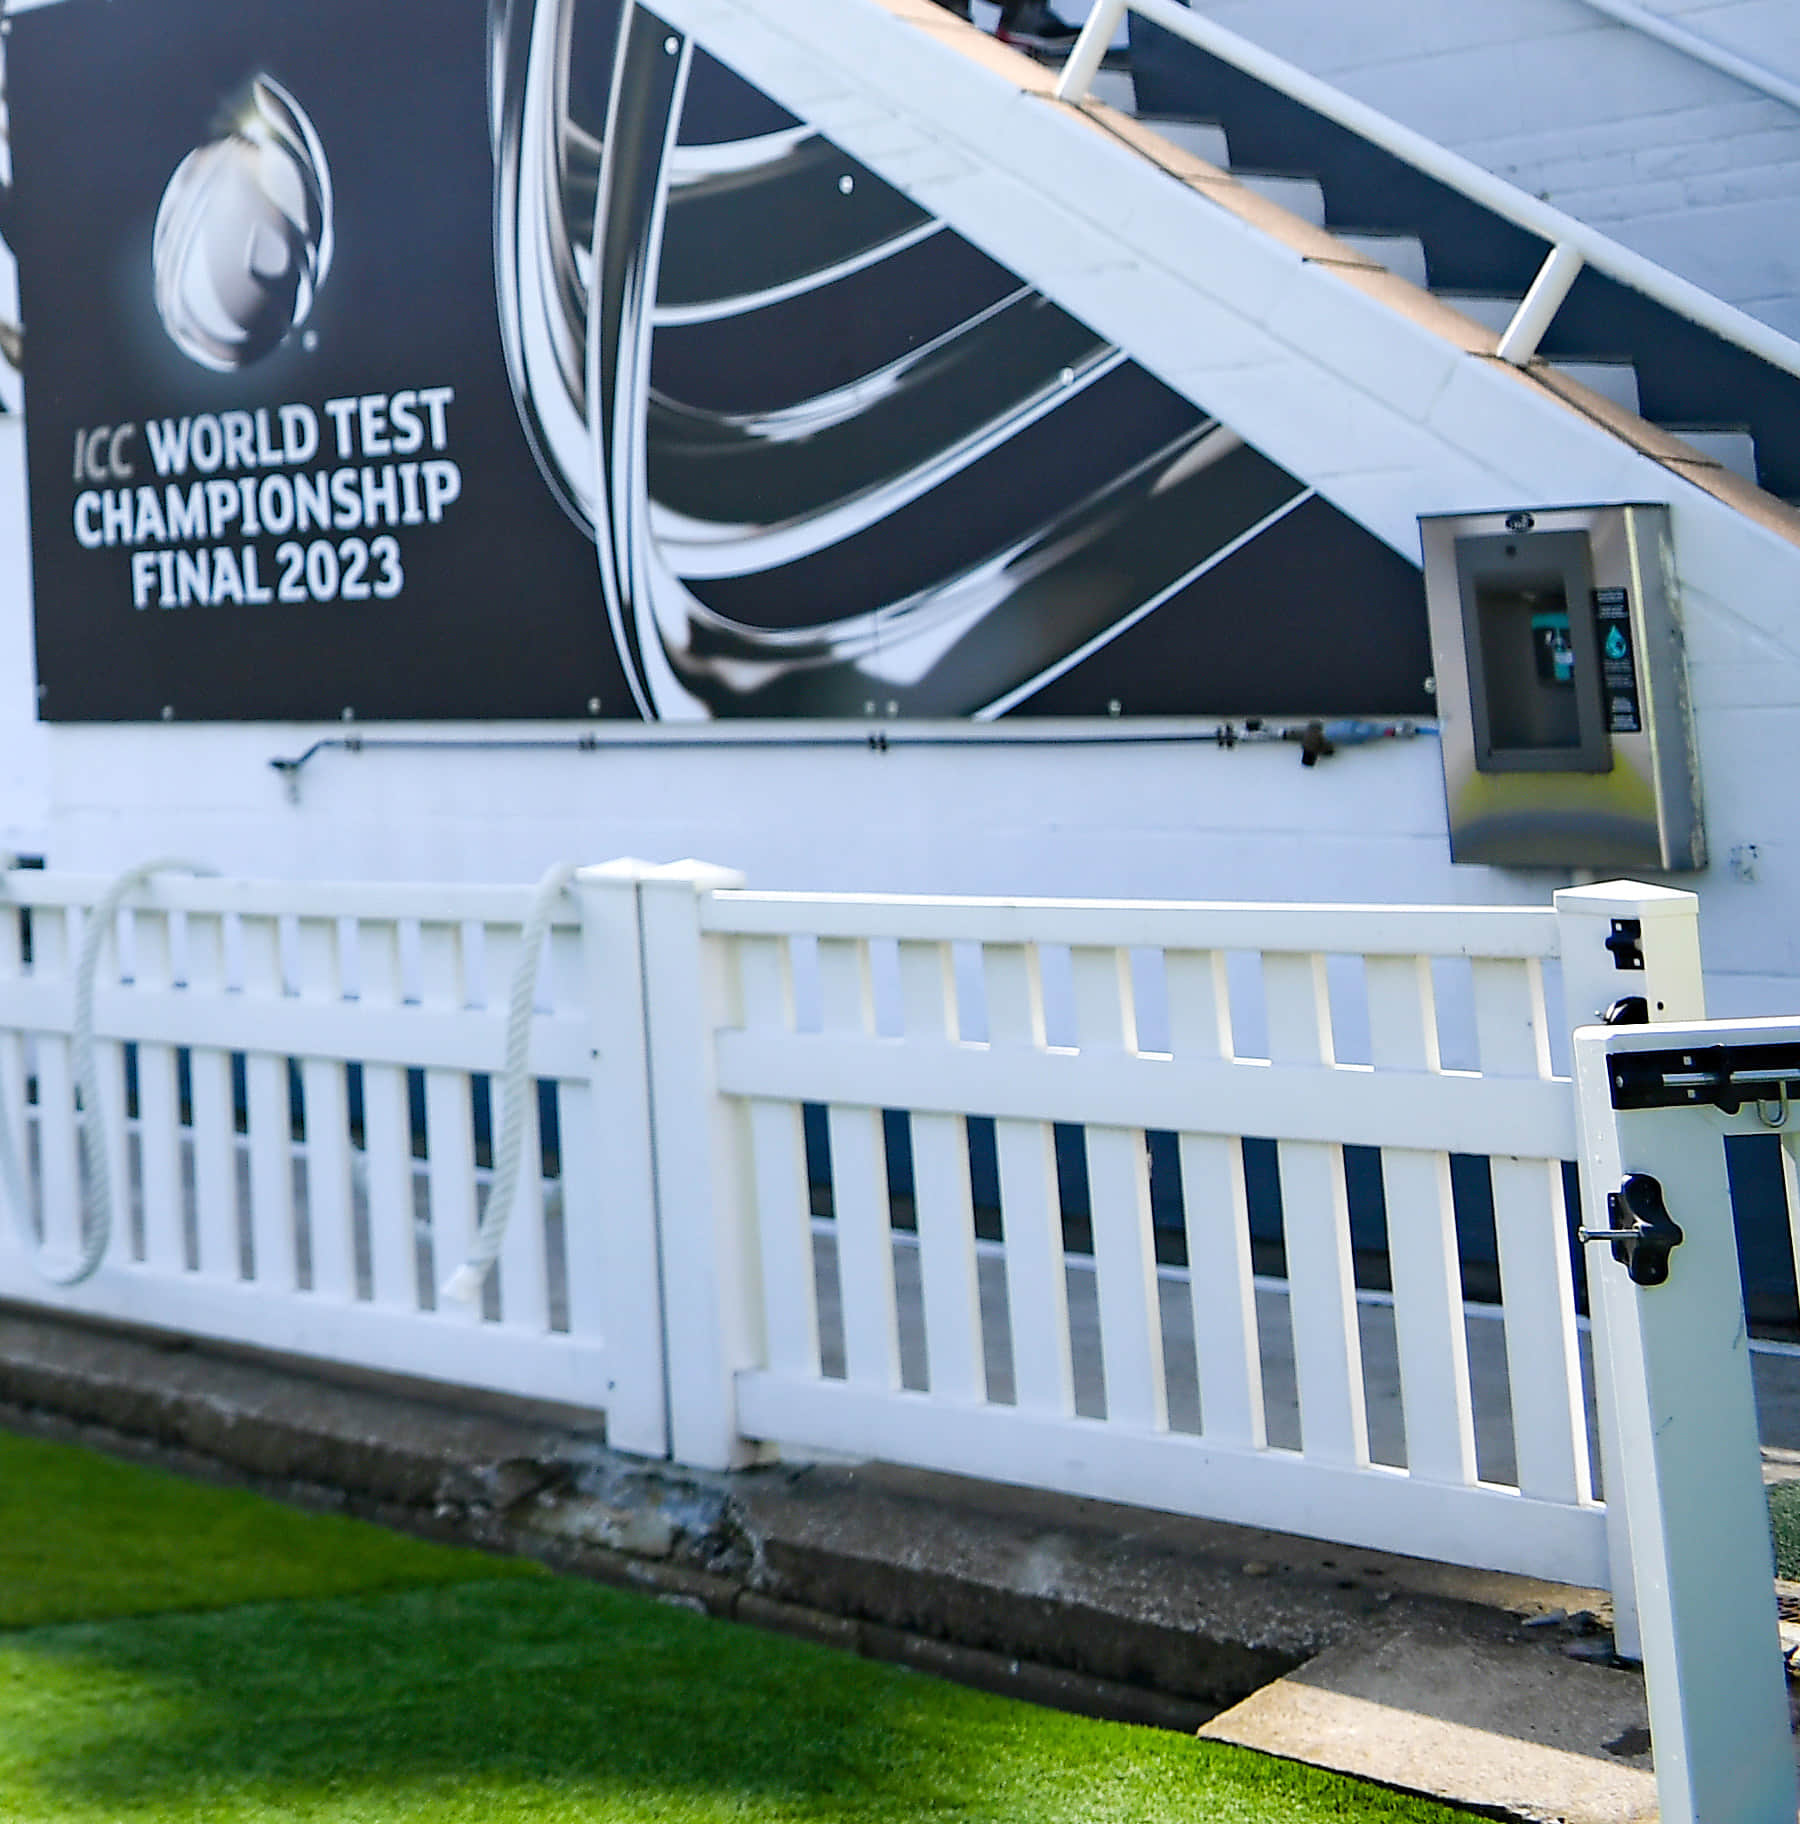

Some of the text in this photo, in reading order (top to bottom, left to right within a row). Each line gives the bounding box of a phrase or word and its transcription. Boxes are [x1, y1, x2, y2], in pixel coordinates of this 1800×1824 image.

[72, 385, 455, 482] ICC WORLD TEST
[72, 459, 462, 549] CHAMPIONSHIP
[131, 535, 404, 610] FINAL 2023
